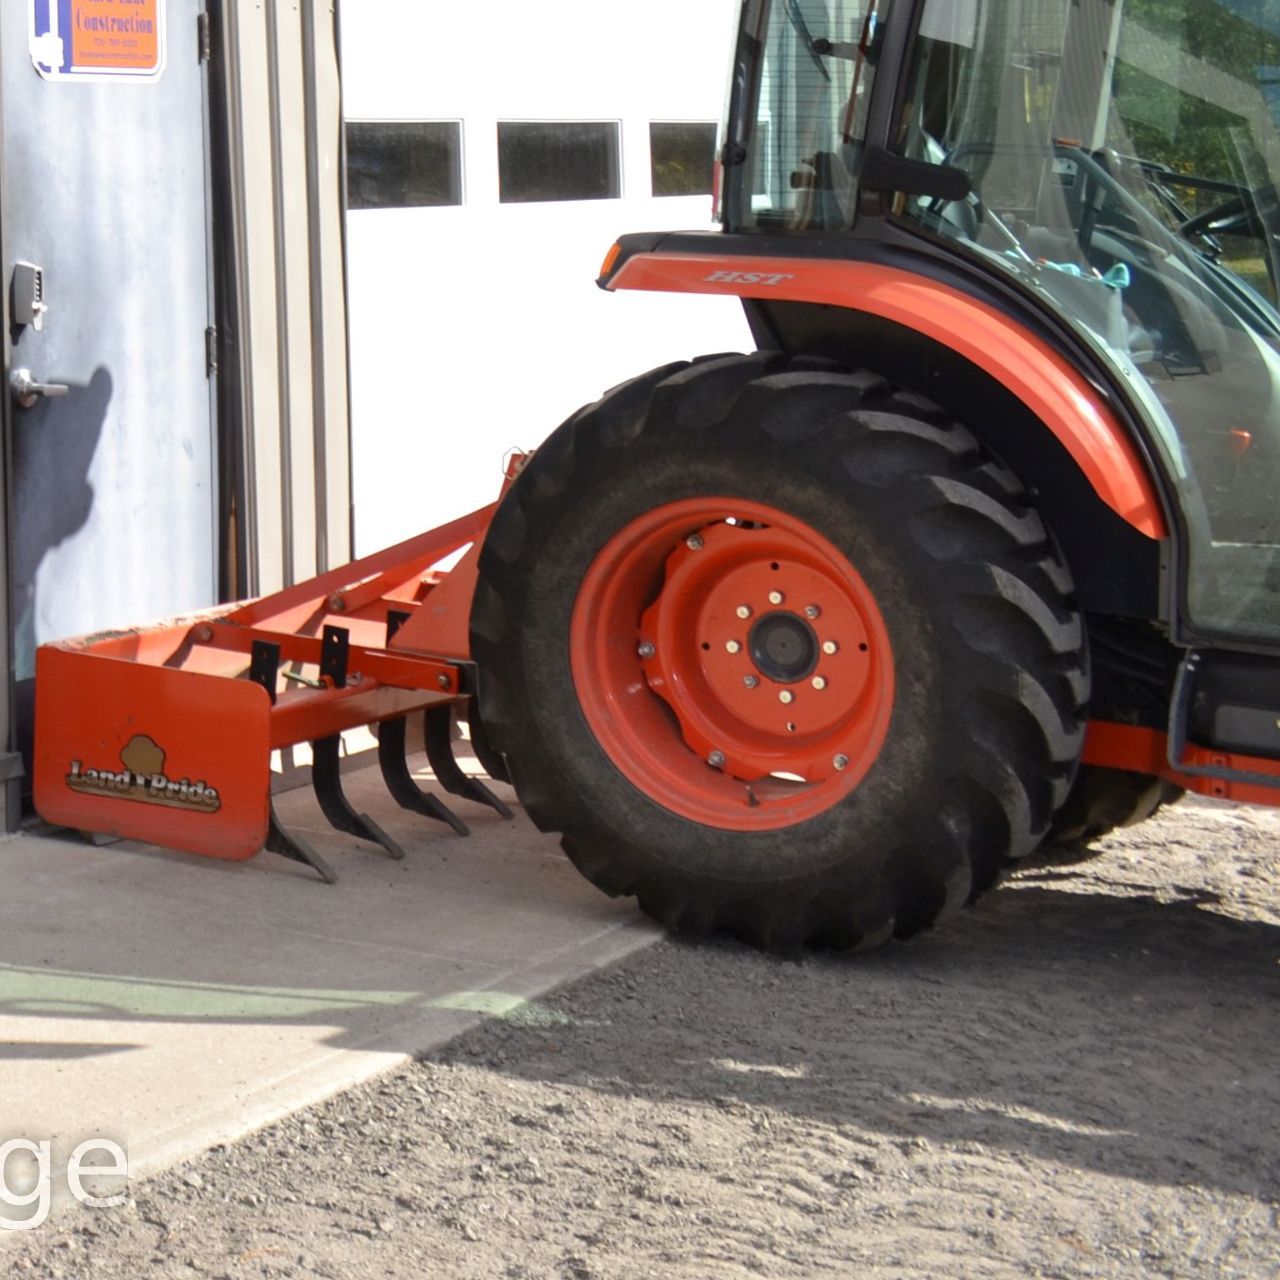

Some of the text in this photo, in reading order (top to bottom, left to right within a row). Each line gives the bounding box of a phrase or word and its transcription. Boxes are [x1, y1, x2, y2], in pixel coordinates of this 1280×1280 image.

[76, 7, 153, 34] Construction
[703, 270, 797, 287] HST
[68, 759, 220, 805] Land Pride
